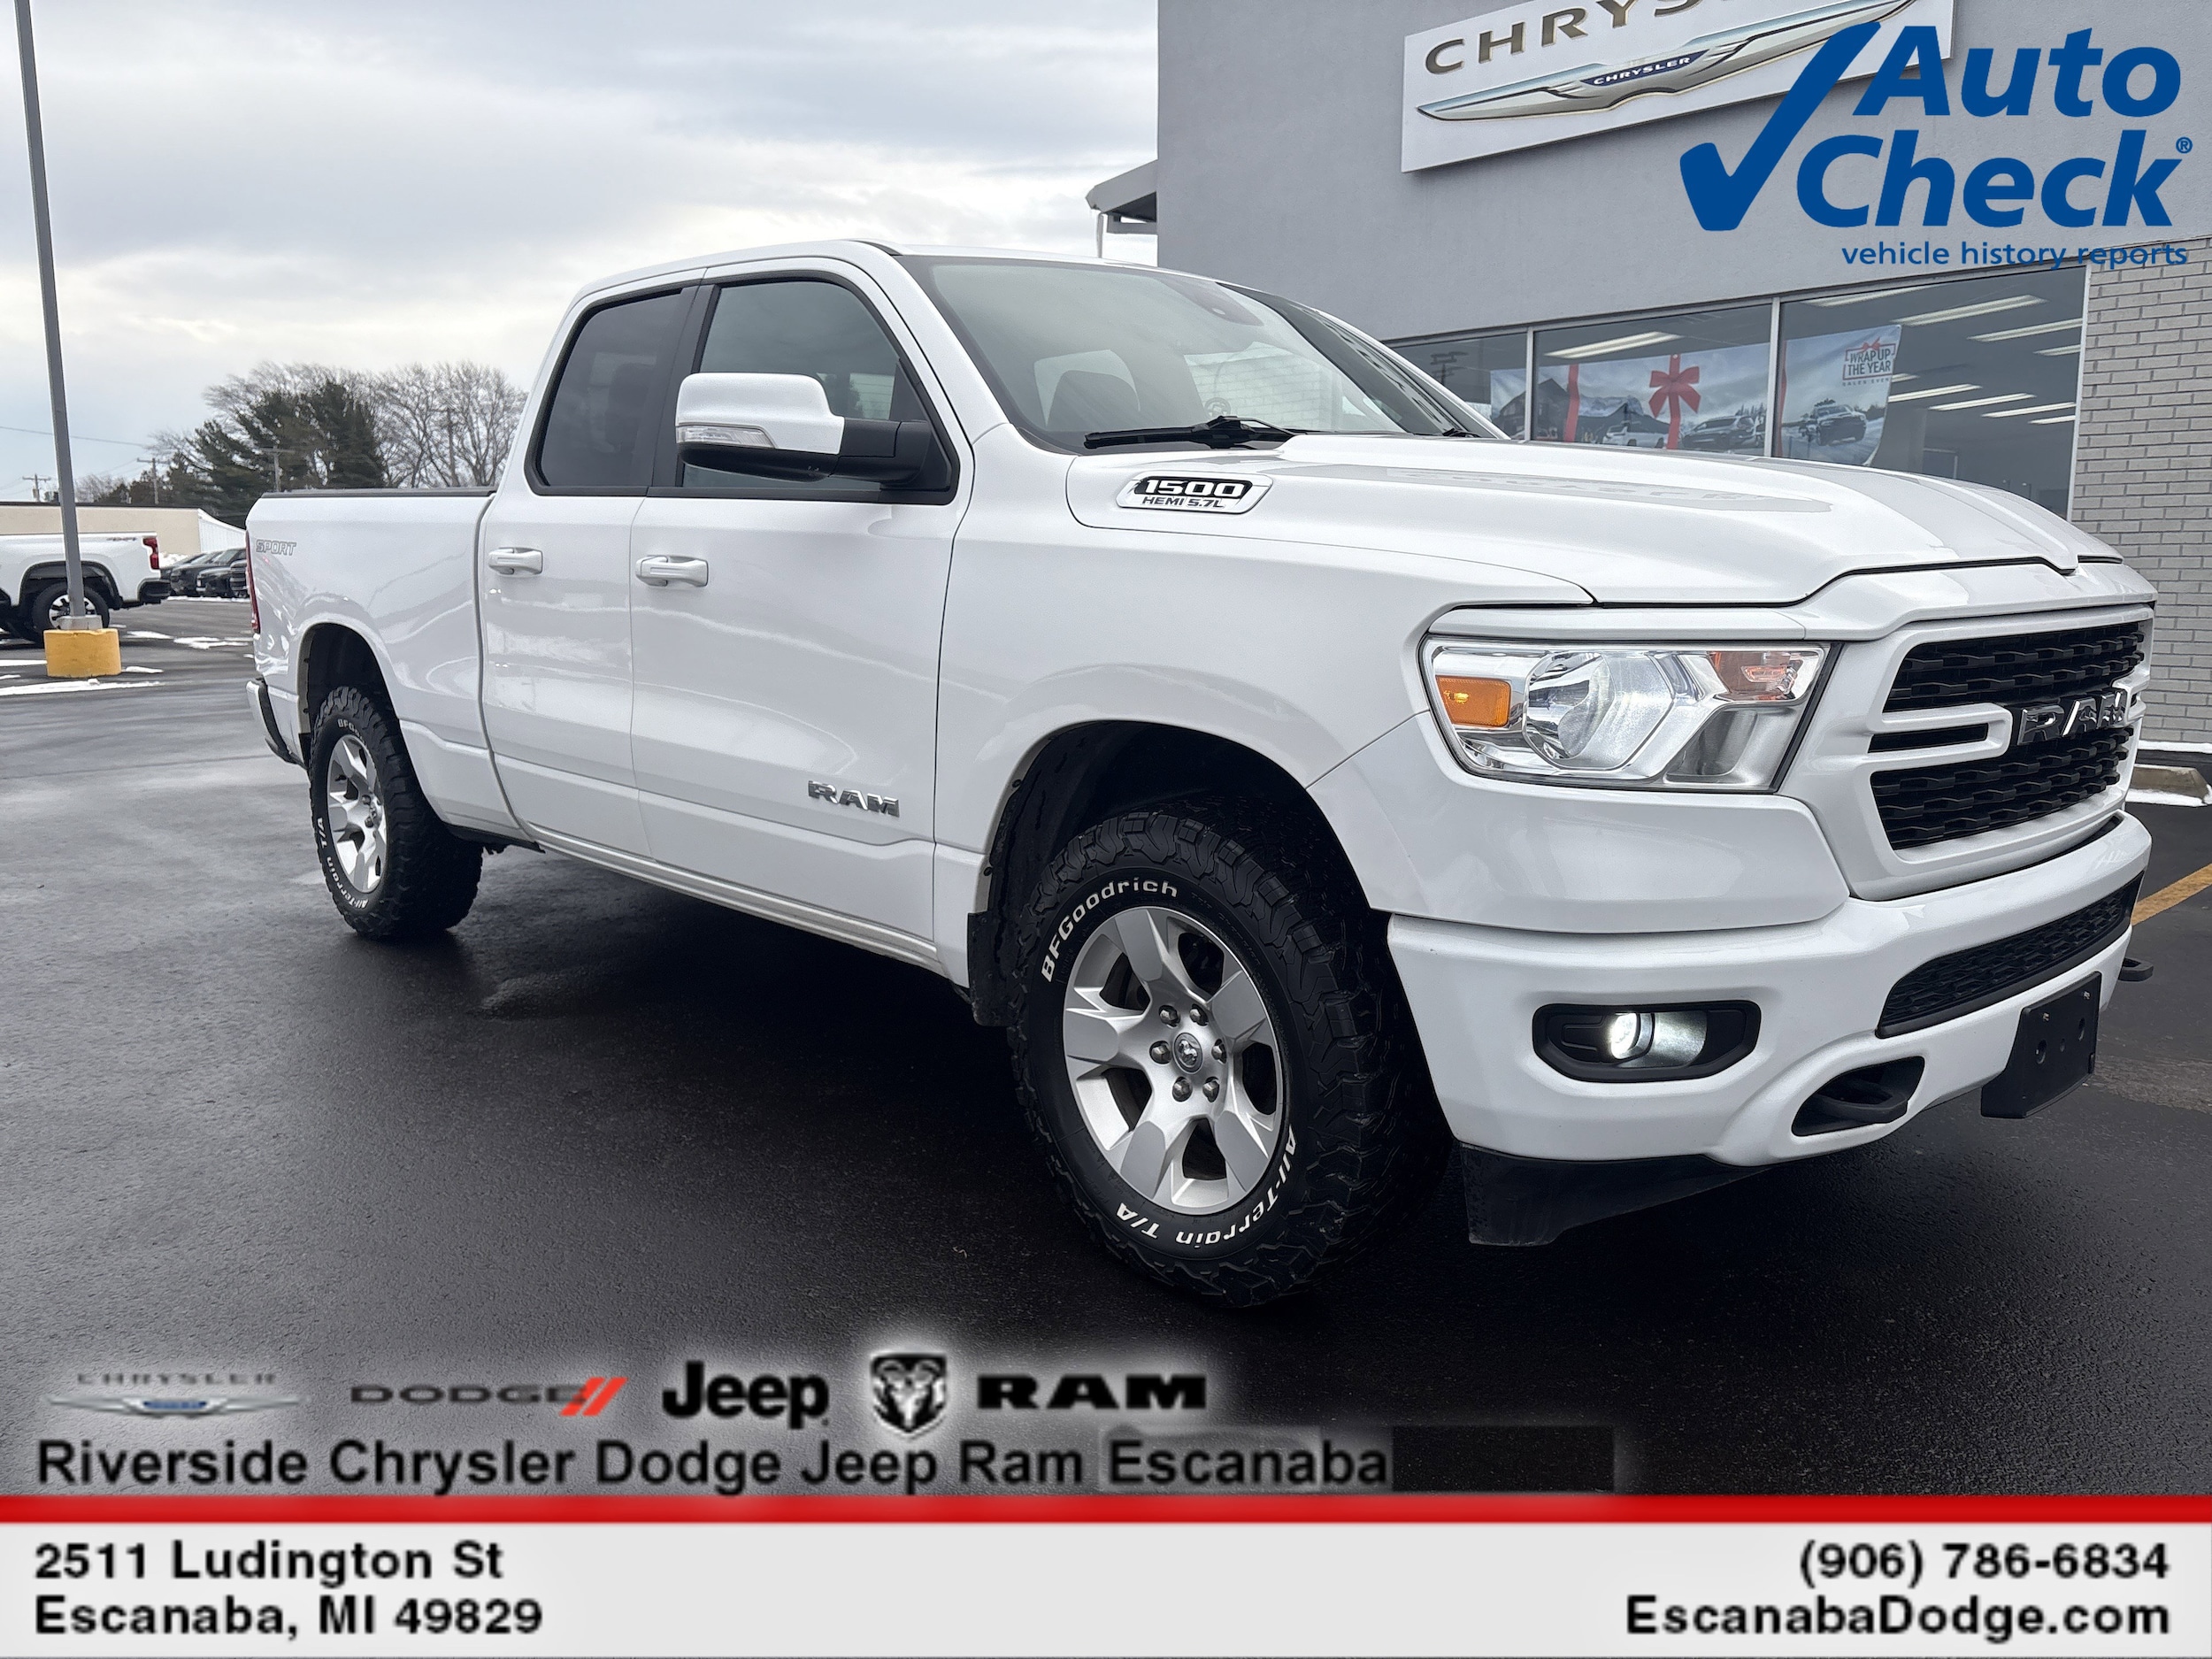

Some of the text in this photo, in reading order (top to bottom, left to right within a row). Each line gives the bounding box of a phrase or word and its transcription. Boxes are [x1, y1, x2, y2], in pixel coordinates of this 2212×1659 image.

[1594, 56, 1691, 87] CHRYSLER
[1847, 360, 1892, 376] THE YEAR
[1850, 348, 1891, 364] WRAP UP
[1141, 495, 1225, 509] HEMI 5.7L
[1145, 479, 1245, 497] 1500
[256, 539, 297, 556] SPORT
[2017, 690, 2125, 746] RAM
[808, 780, 900, 818] RAM
[1041, 877, 1178, 982] BFGoodrich
[1175, 1124, 1297, 1248] All-Terrain
[1116, 1202, 1160, 1240] T/A
